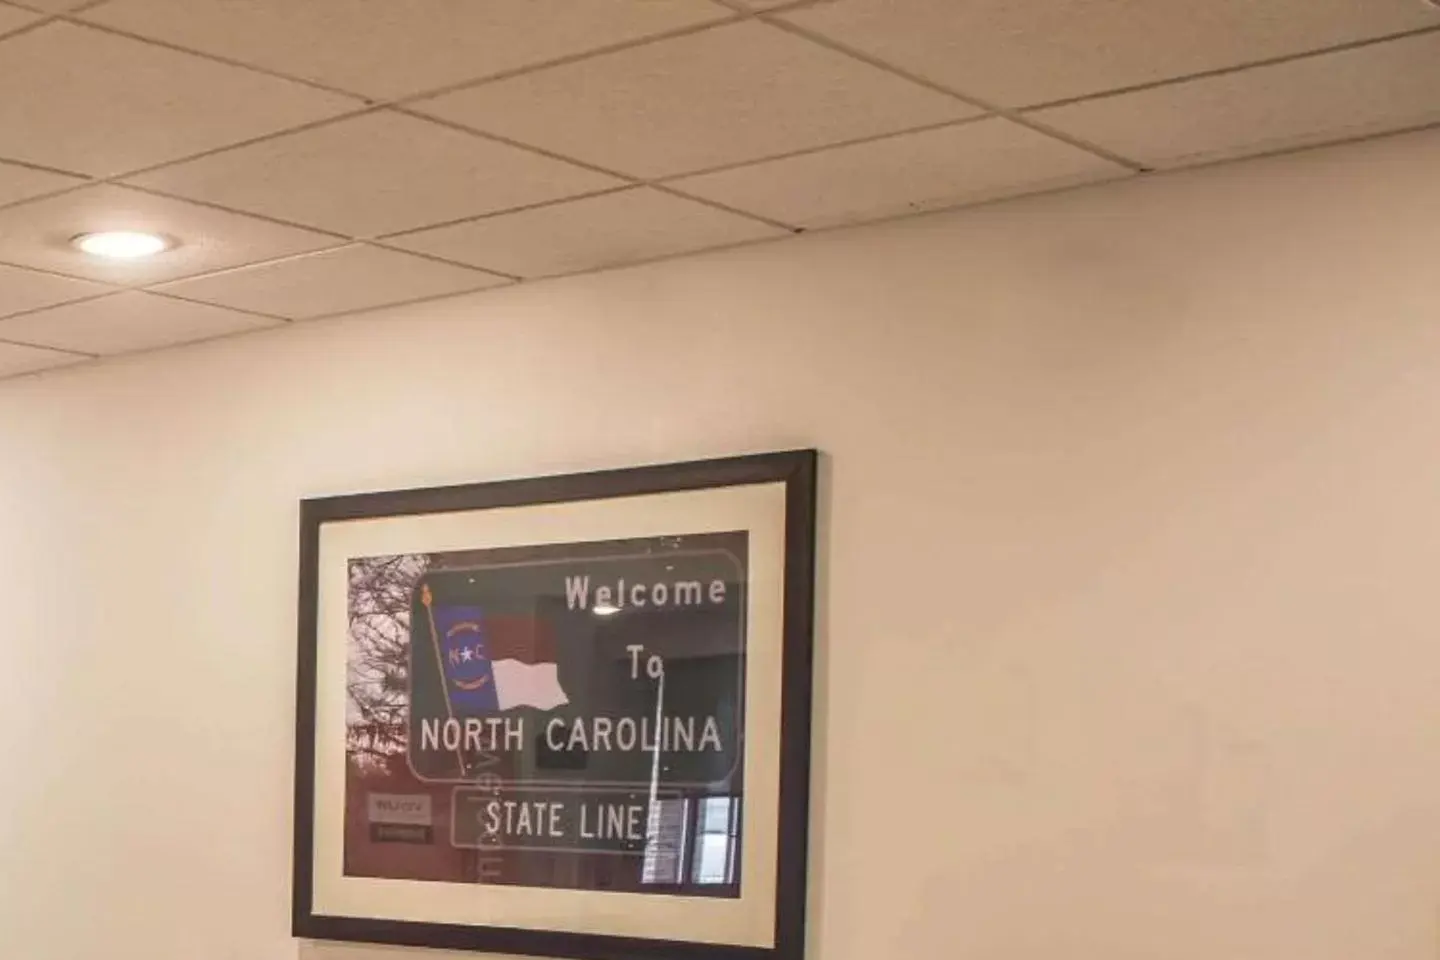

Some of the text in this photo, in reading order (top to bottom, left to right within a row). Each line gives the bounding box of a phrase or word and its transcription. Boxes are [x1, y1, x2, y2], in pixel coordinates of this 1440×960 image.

[565, 575, 726, 610] Welcome
[626, 643, 664, 680] To
[420, 716, 723, 752] NORTH CAROLINA
[484, 801, 644, 840] STATE LINE
